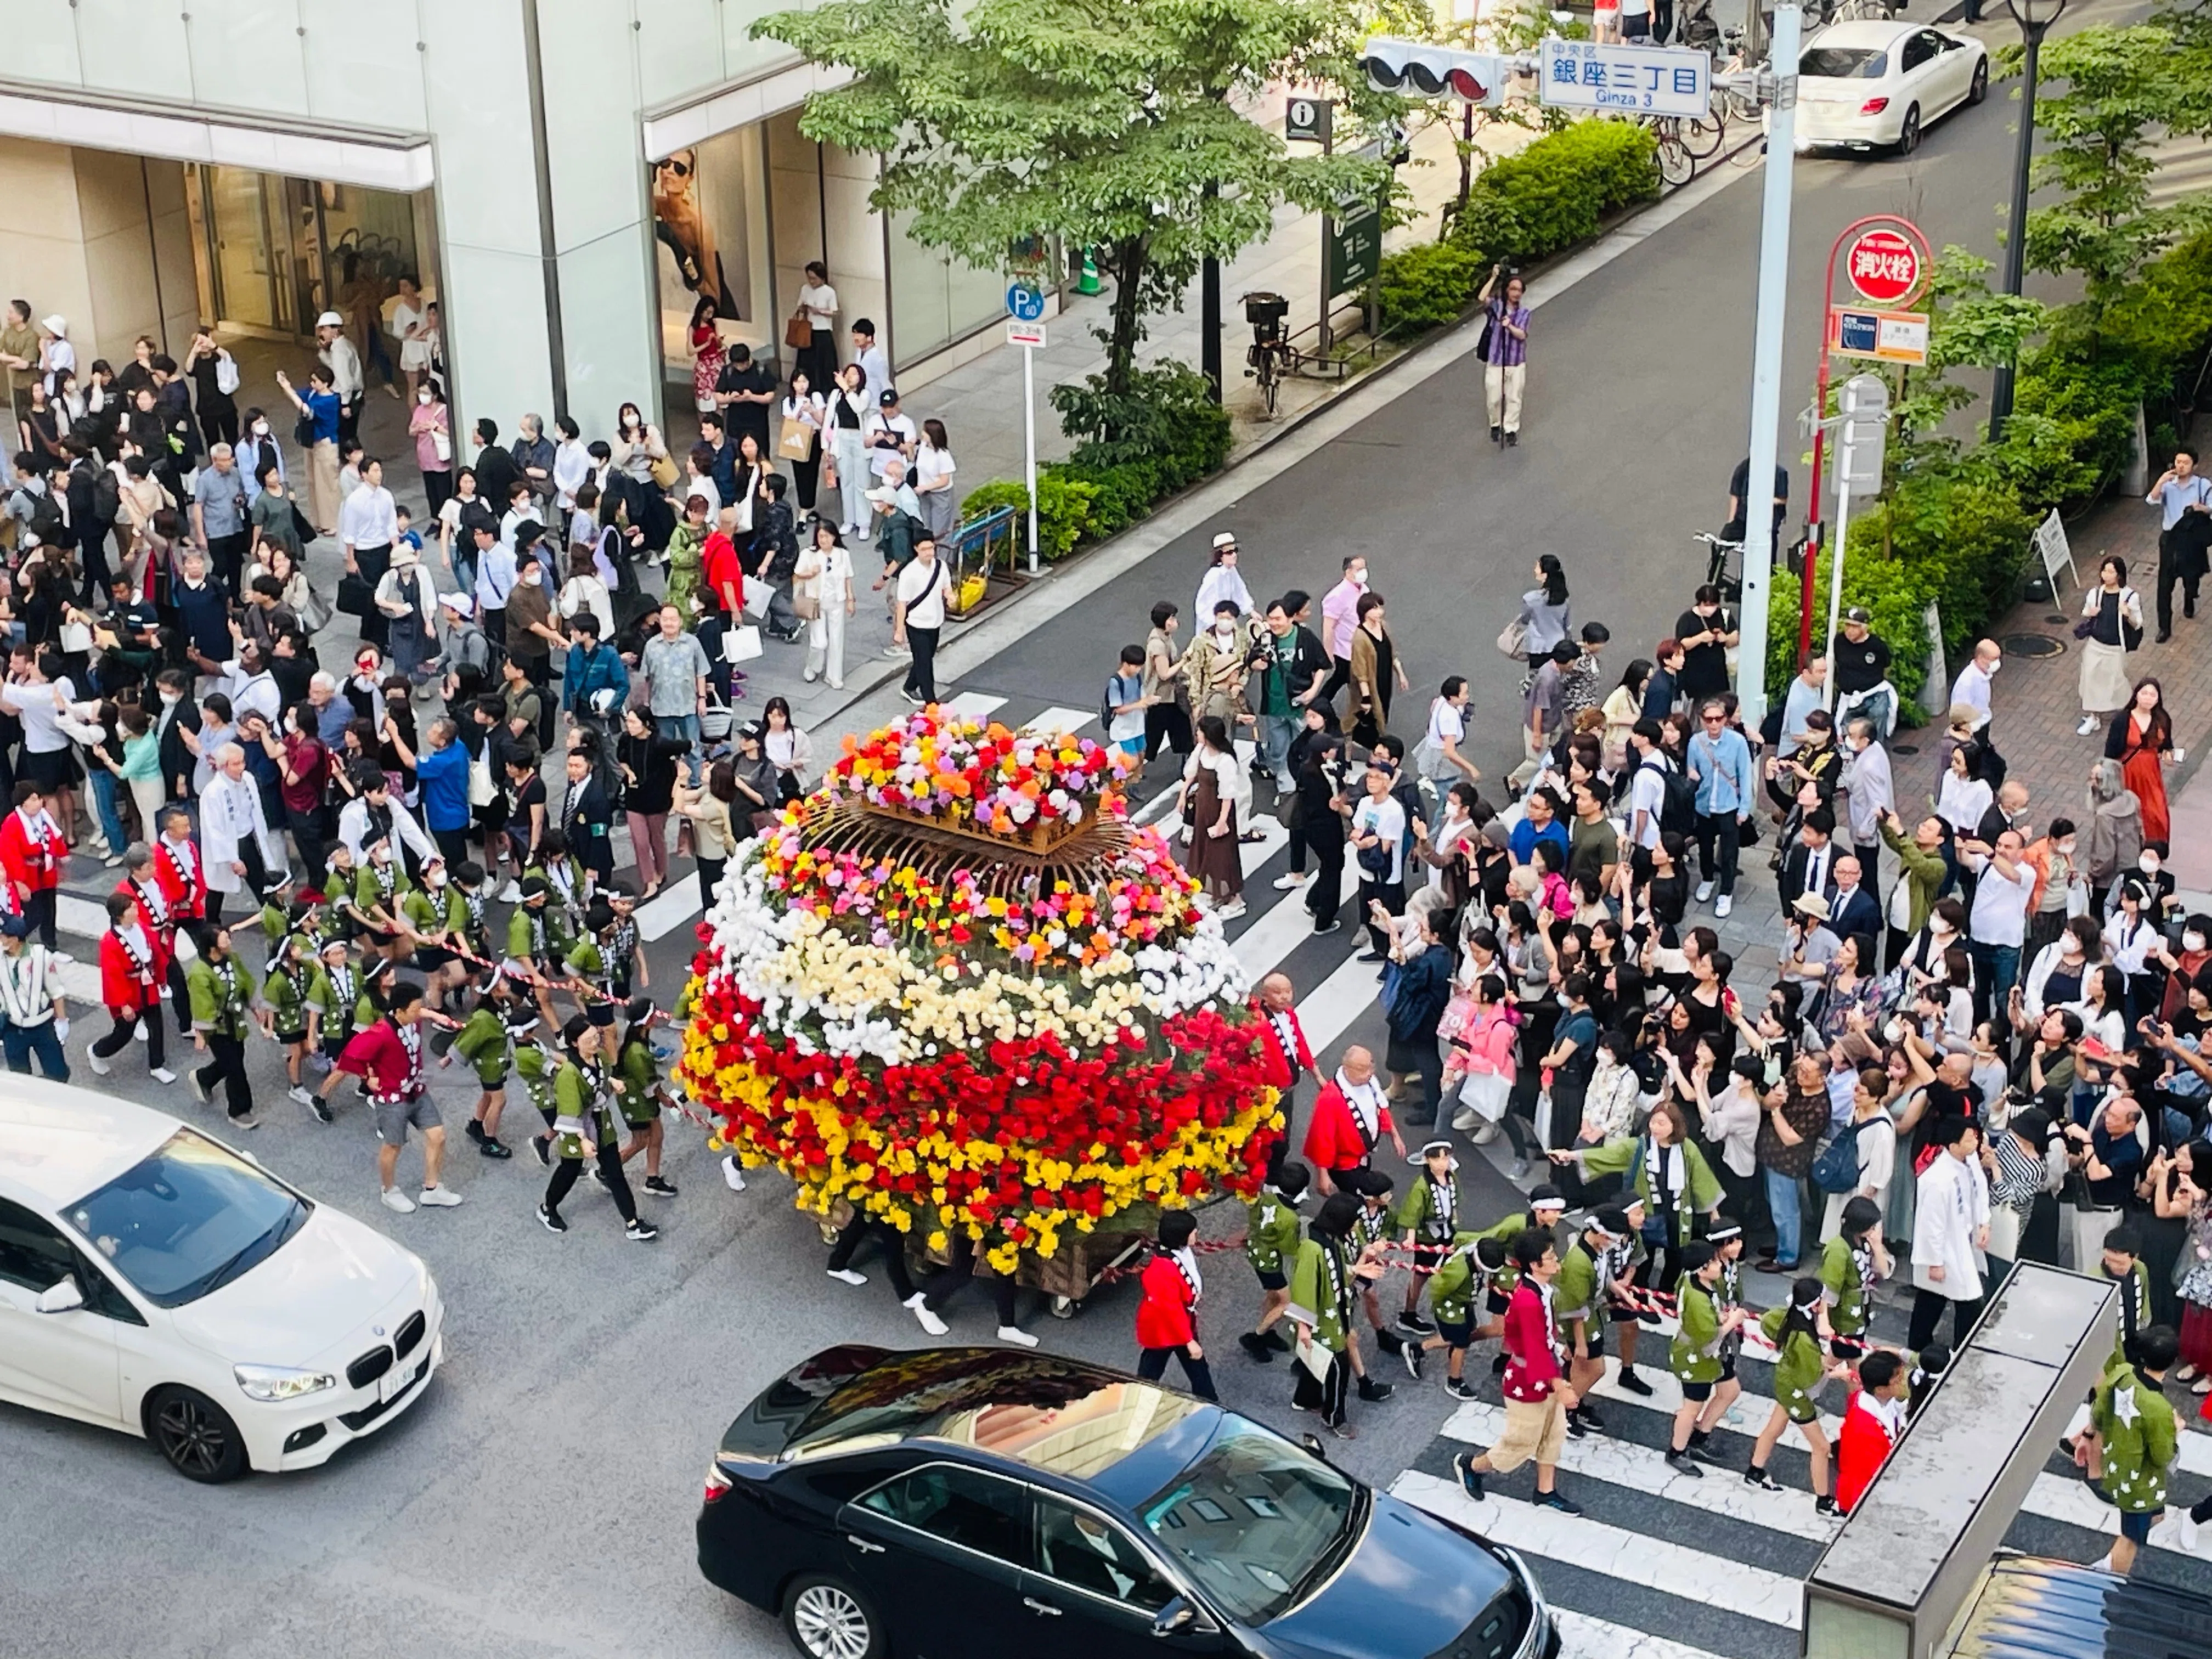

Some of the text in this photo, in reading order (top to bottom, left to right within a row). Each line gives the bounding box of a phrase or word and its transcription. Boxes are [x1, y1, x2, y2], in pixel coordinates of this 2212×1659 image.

[1552, 43, 1597, 59] 中央区
[1552, 59, 1696, 94] 銀座三丁目
[1595, 89, 1653, 108] Ginza 3
[1855, 250, 1913, 284] 消火栓
[1015, 289, 1030, 315] P
